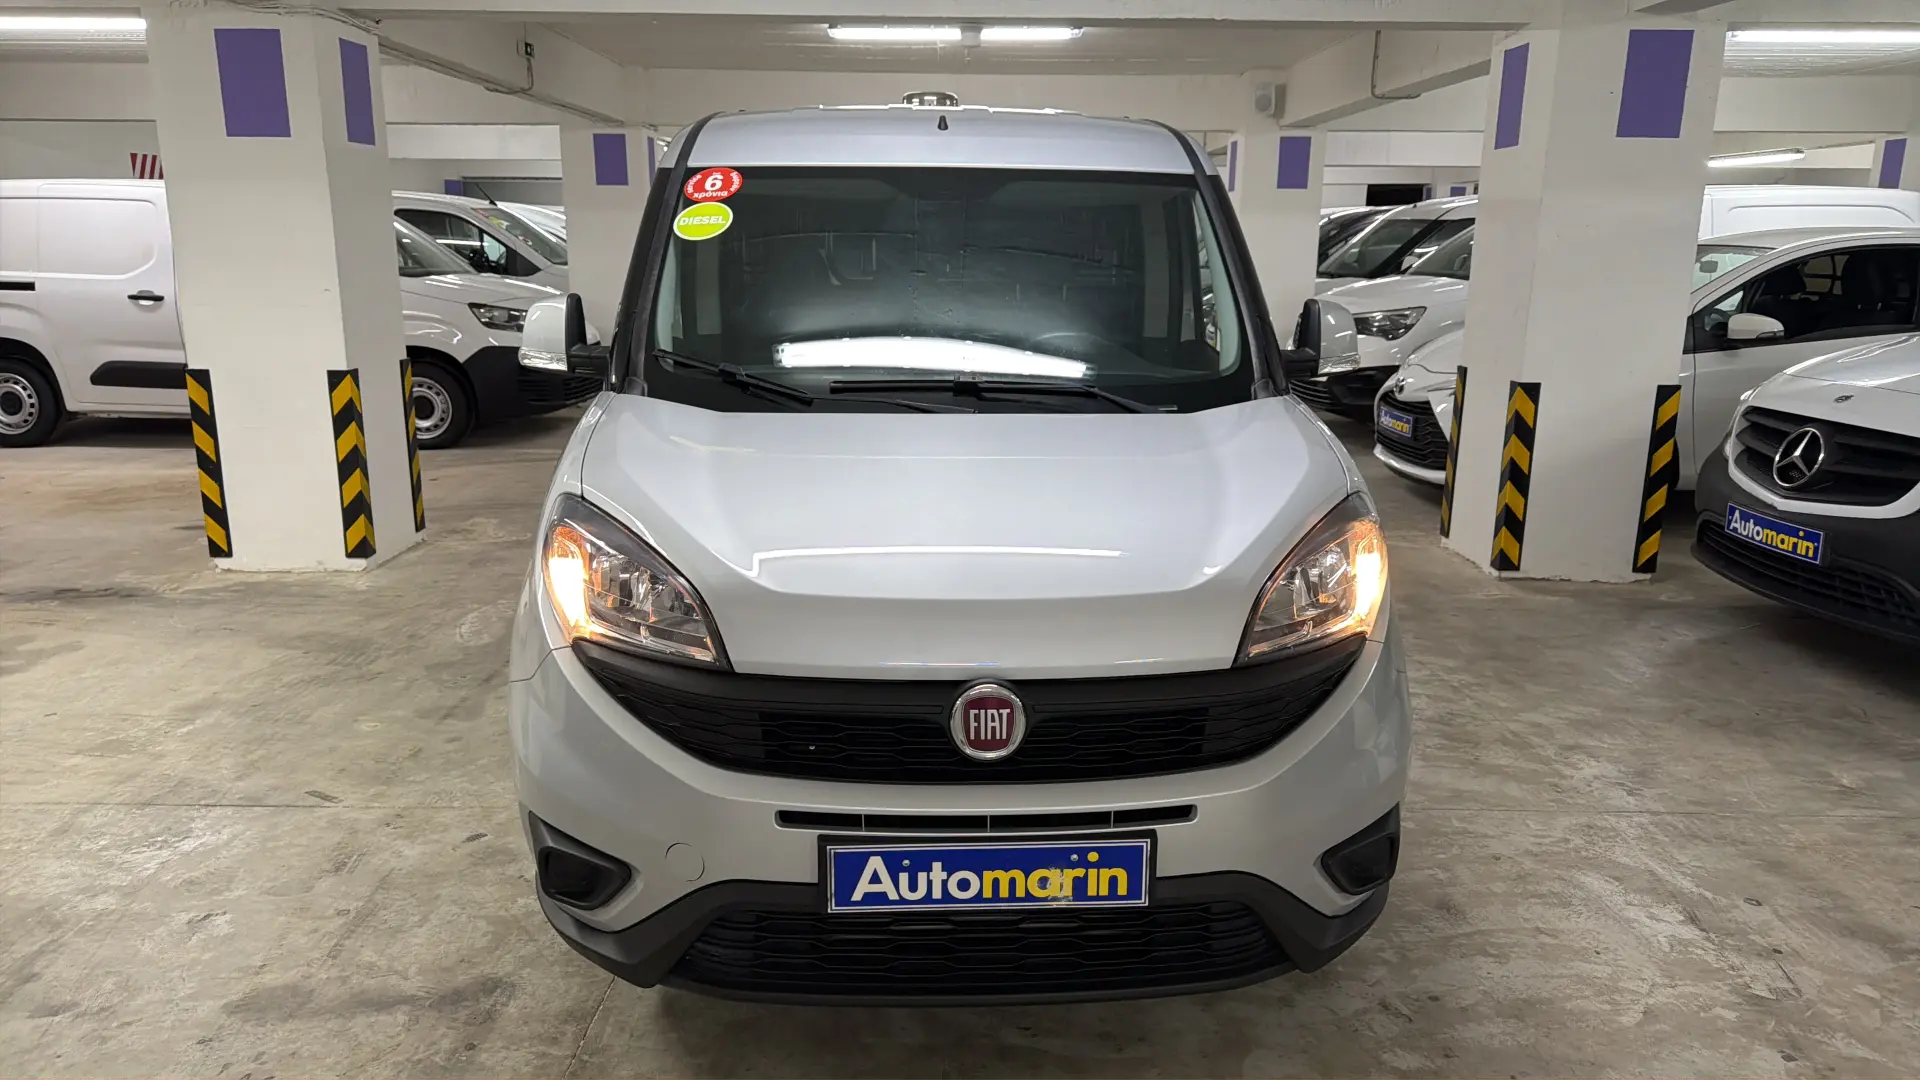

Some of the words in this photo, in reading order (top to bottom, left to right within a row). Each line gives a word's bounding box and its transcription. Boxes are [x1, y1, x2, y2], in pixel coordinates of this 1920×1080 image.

[693, 190, 728, 199] χρόνια
[705, 175, 724, 191] 6
[679, 216, 725, 225] DIESEL
[1729, 509, 1815, 558] Automarin
[969, 709, 1011, 740] FIAT
[850, 851, 1128, 902] Automarin
